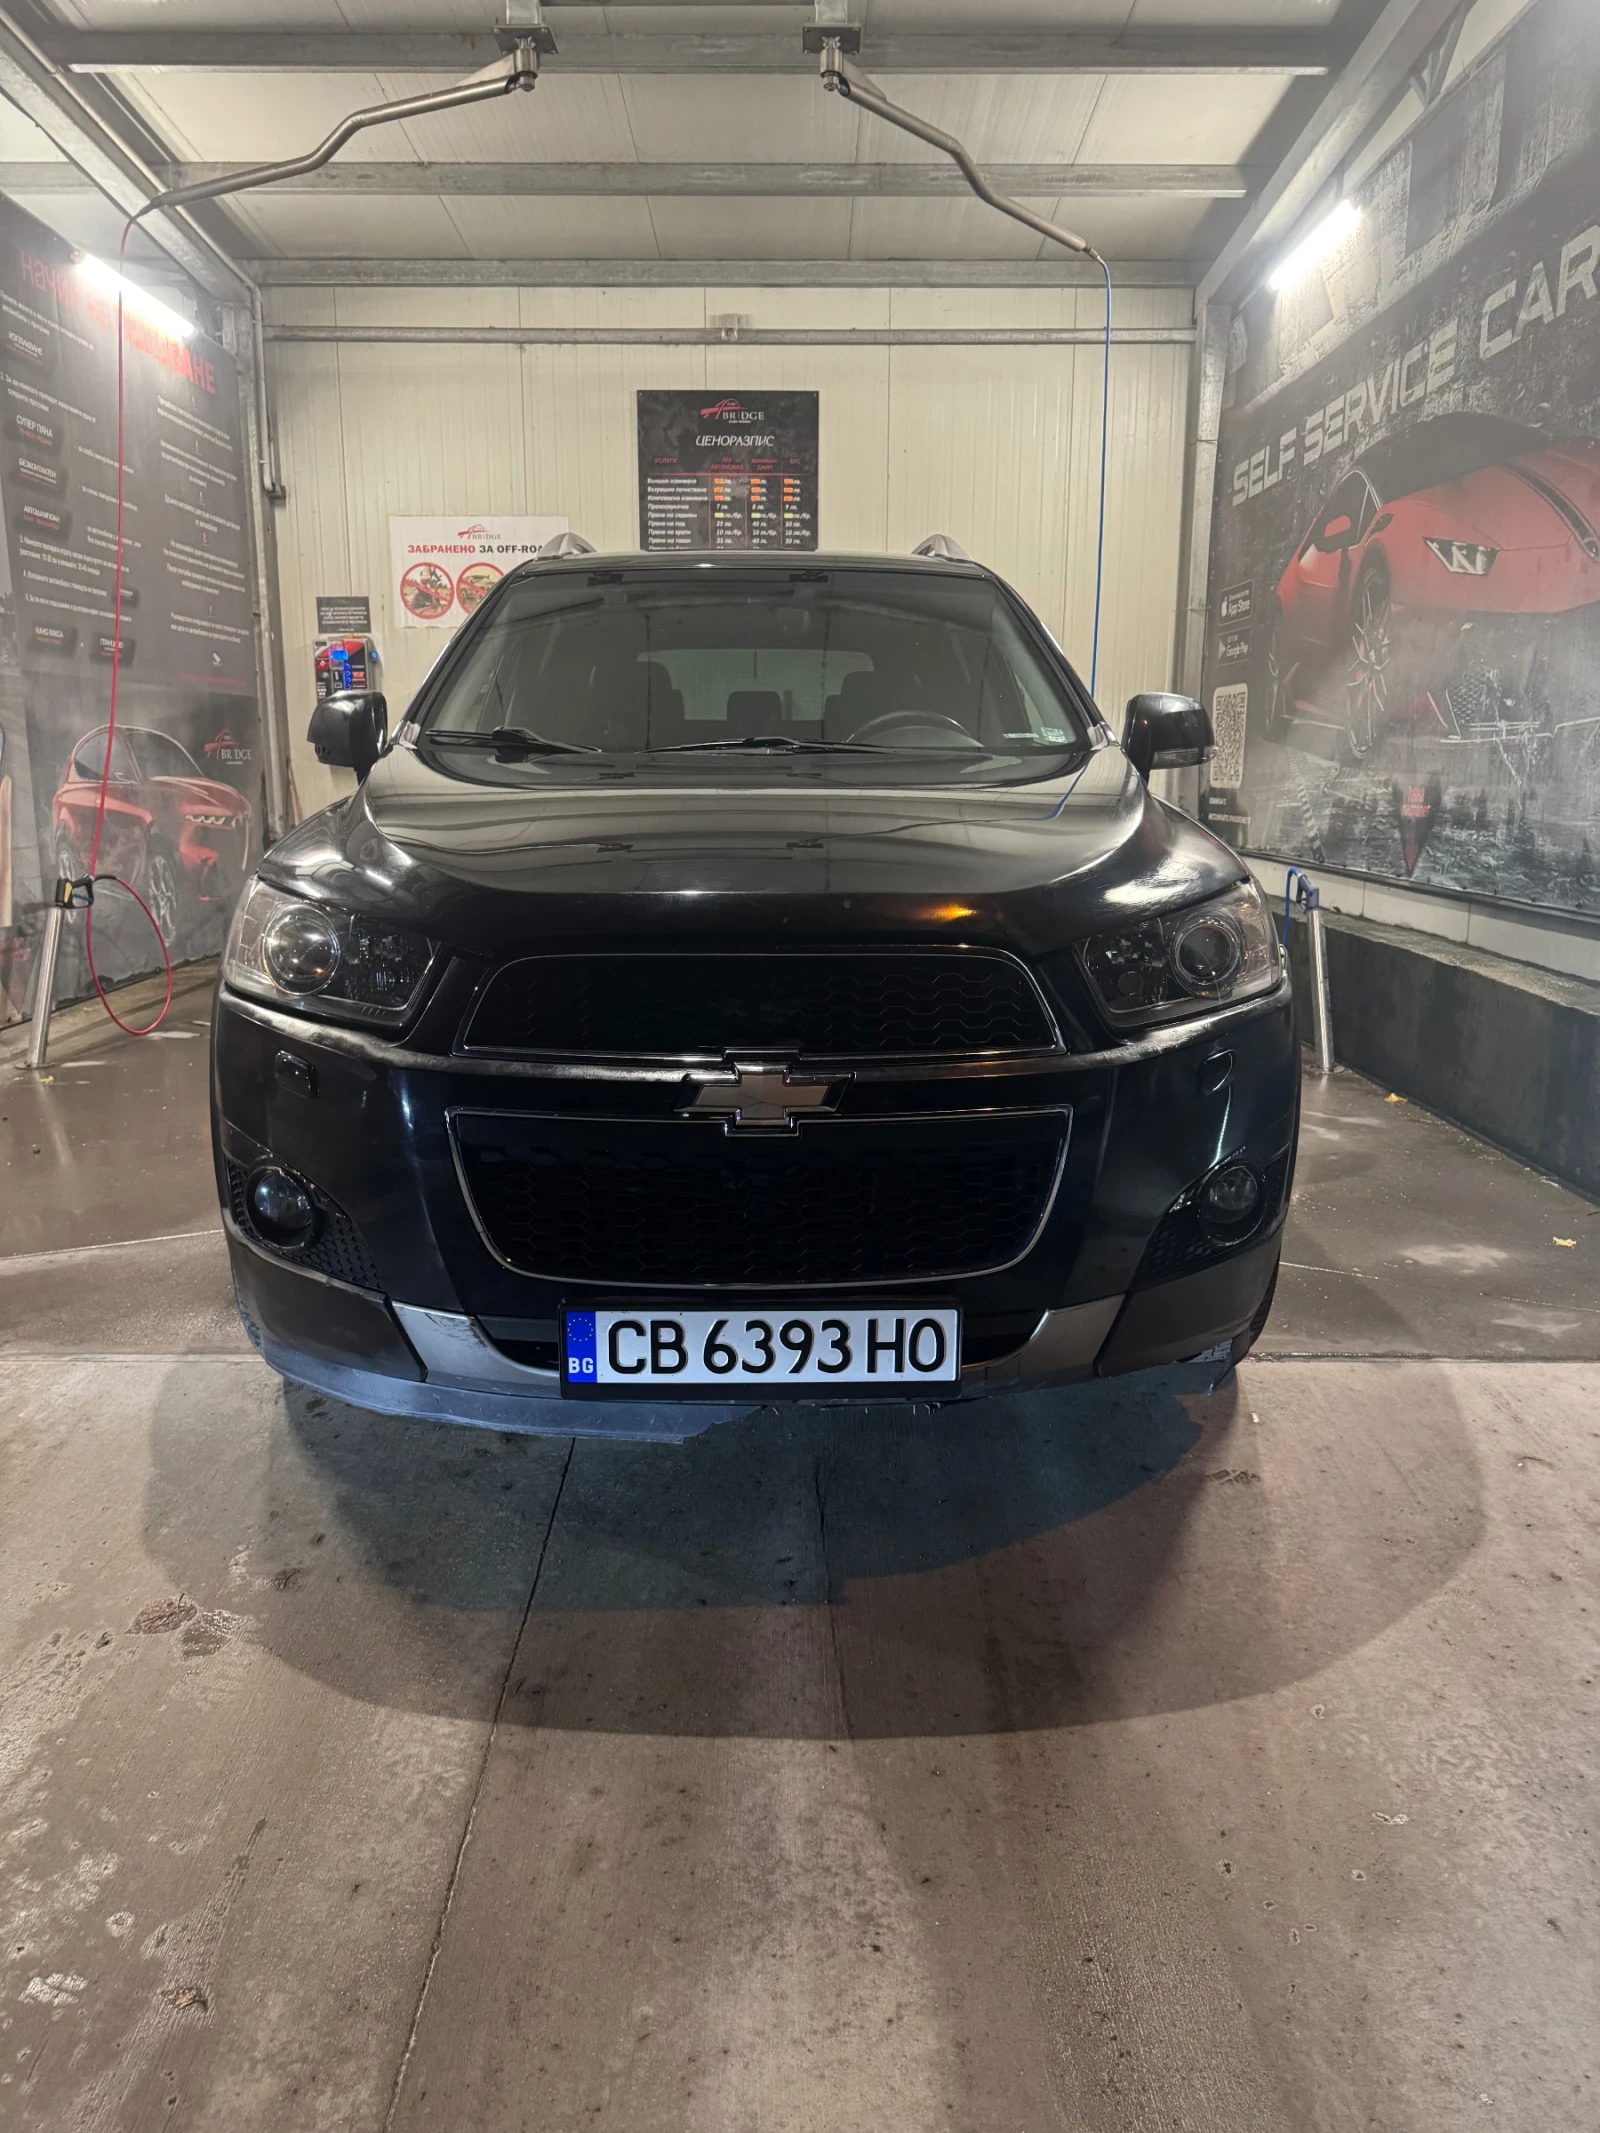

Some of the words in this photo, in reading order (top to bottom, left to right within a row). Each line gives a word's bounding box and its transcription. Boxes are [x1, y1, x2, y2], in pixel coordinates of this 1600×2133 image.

[1232, 427, 1297, 507] SELF
[1303, 318, 1458, 467] SERVICE
[1480, 225, 1600, 360] CAR
[722, 411, 765, 421] BRIDGE
[16, 415, 36, 431] СУПЕР
[36, 422, 53, 438] ПЯНА
[695, 435, 775, 447] ЦЕНОРАЗПИС
[654, 457, 678, 465] УСЛУГИ
[789, 457, 801, 465] БУС
[408, 544, 476, 554] ЗАБРАНЕНО
[479, 544, 494, 554] ЗА
[1228, 602, 1238, 617] App
[1237, 599, 1250, 612] Store
[35, 626, 49, 636] НАНО
[49, 627, 64, 638] ВАКСА
[1227, 643, 1241, 658] Google
[607, 1319, 689, 1375] CB
[702, 1318, 853, 1375] 6393
[866, 1318, 947, 1374] HO
[568, 1357, 594, 1374] BG
